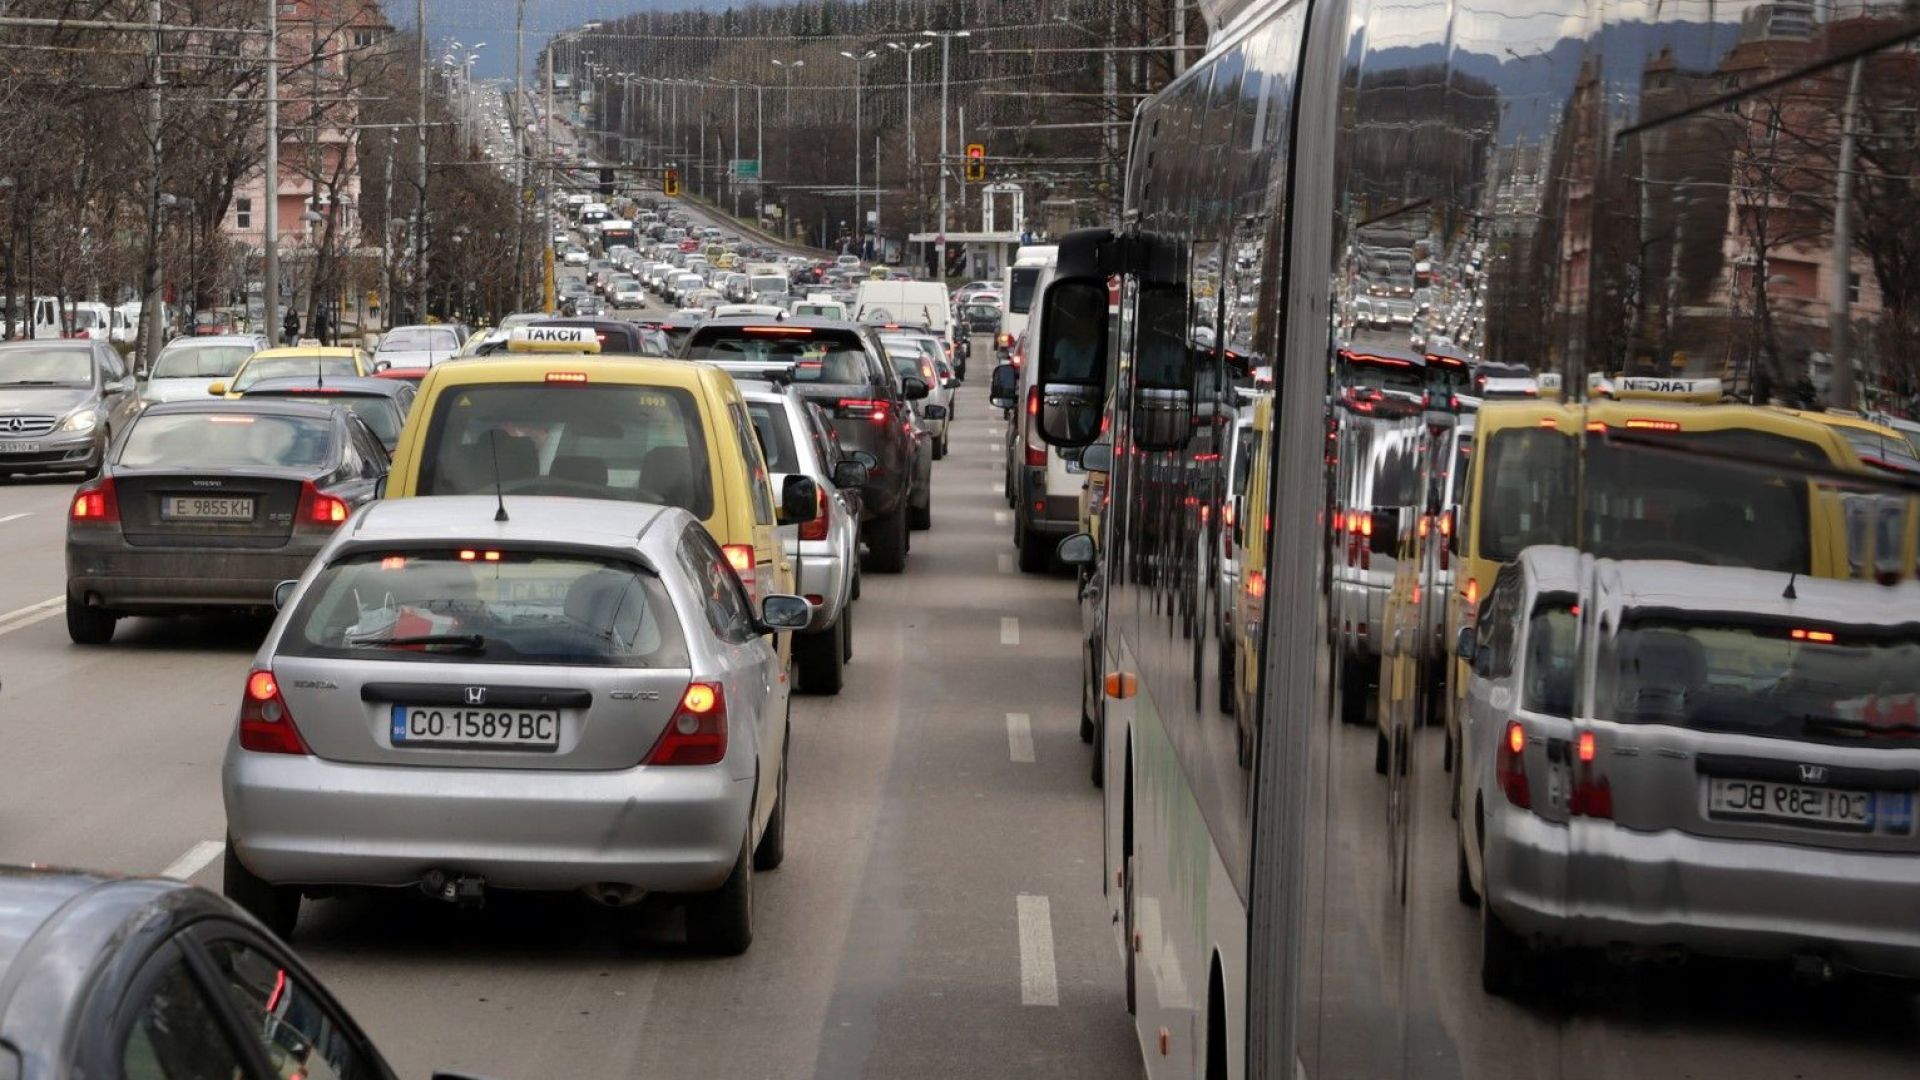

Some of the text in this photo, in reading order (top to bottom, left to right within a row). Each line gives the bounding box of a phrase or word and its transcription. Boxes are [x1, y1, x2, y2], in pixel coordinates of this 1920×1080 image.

[526, 329, 581, 341] ТАКСИ
[177, 499, 250, 516] E 9855 KH
[453, 711, 513, 739] 1589
[518, 713, 553, 740] BC
